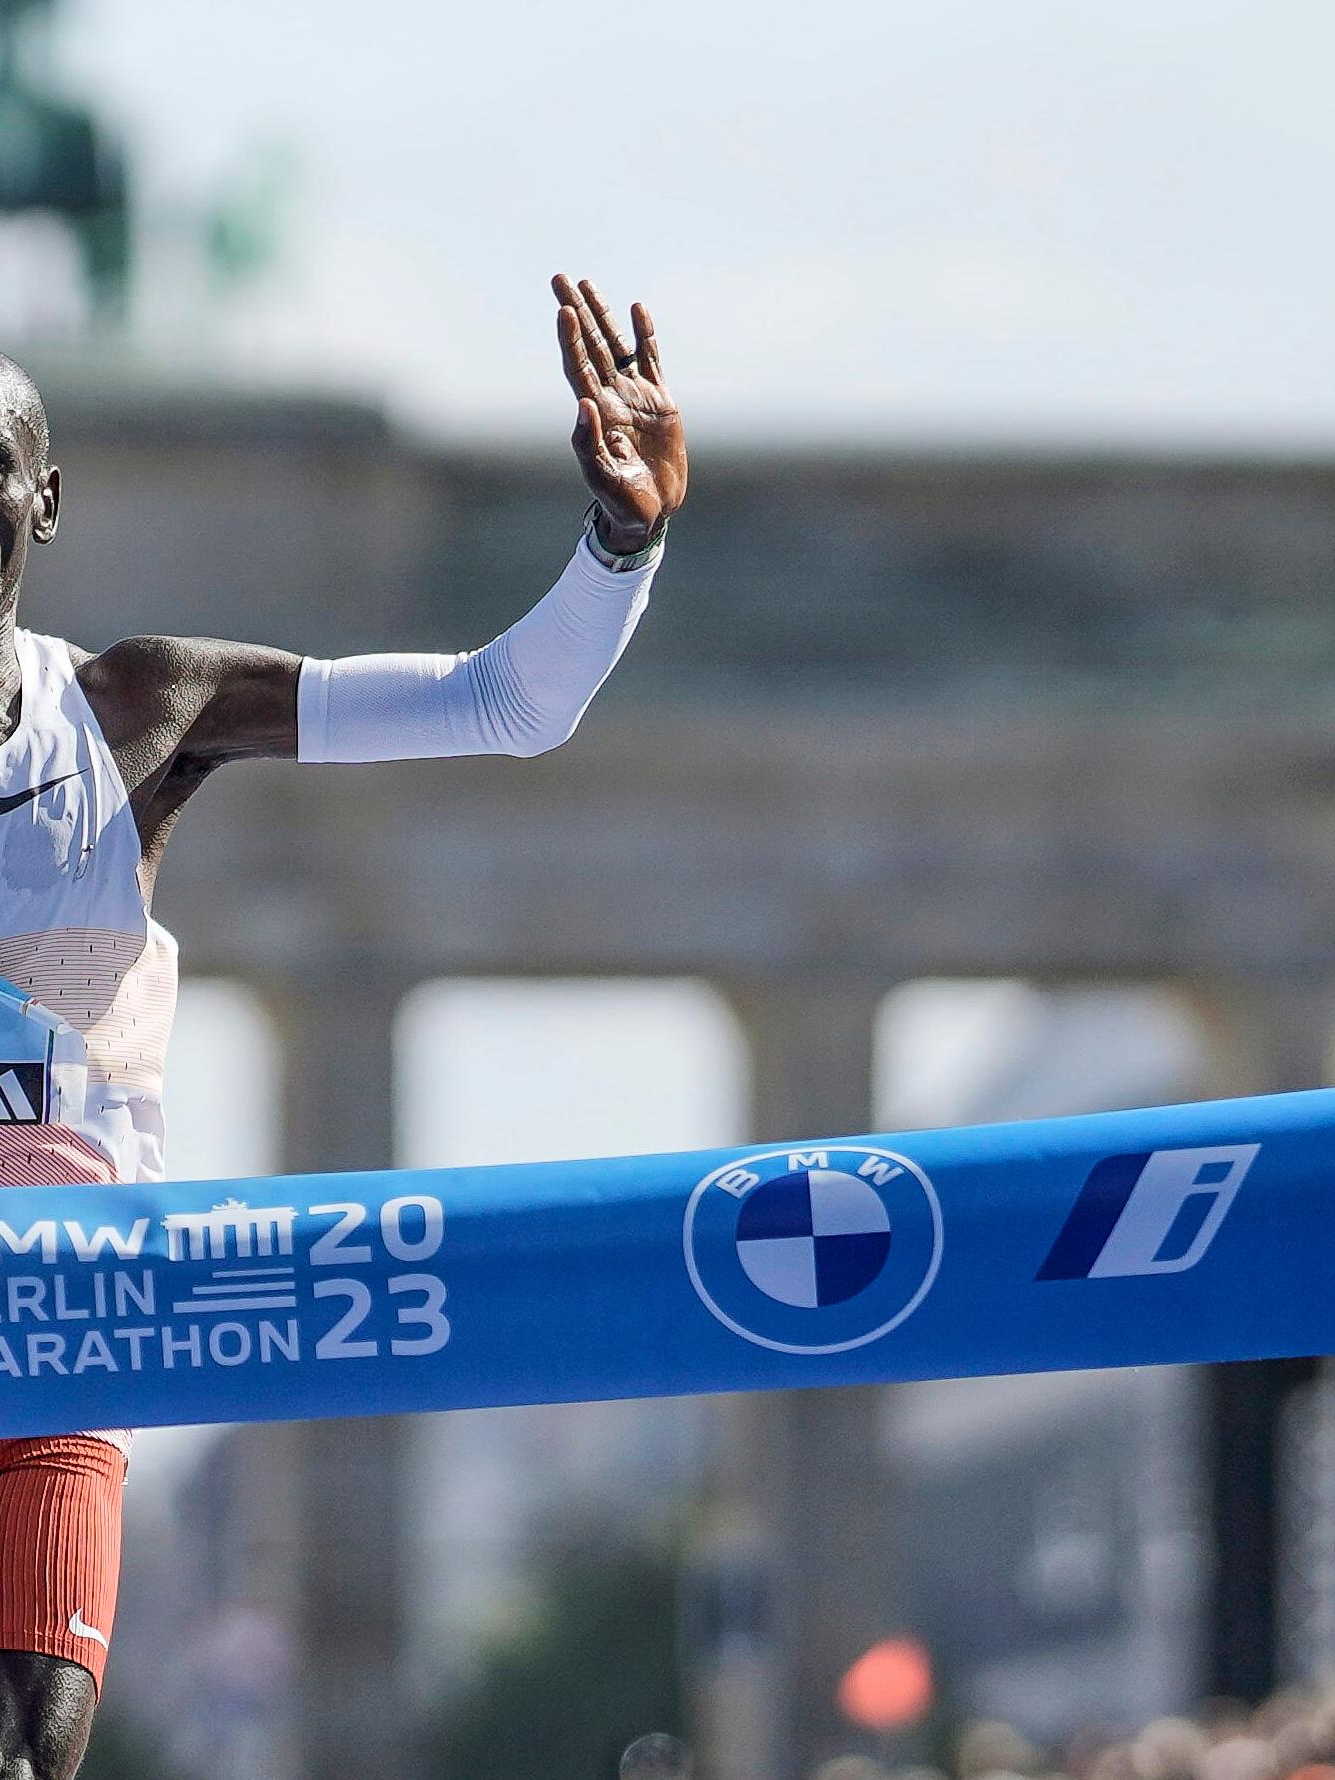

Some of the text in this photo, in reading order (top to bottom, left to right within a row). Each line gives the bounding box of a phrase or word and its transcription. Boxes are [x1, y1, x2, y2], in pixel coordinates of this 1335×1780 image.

[715, 1150, 905, 1201] BMW
[308, 1196, 444, 1267] 20
[313, 1273, 451, 1360] 23
